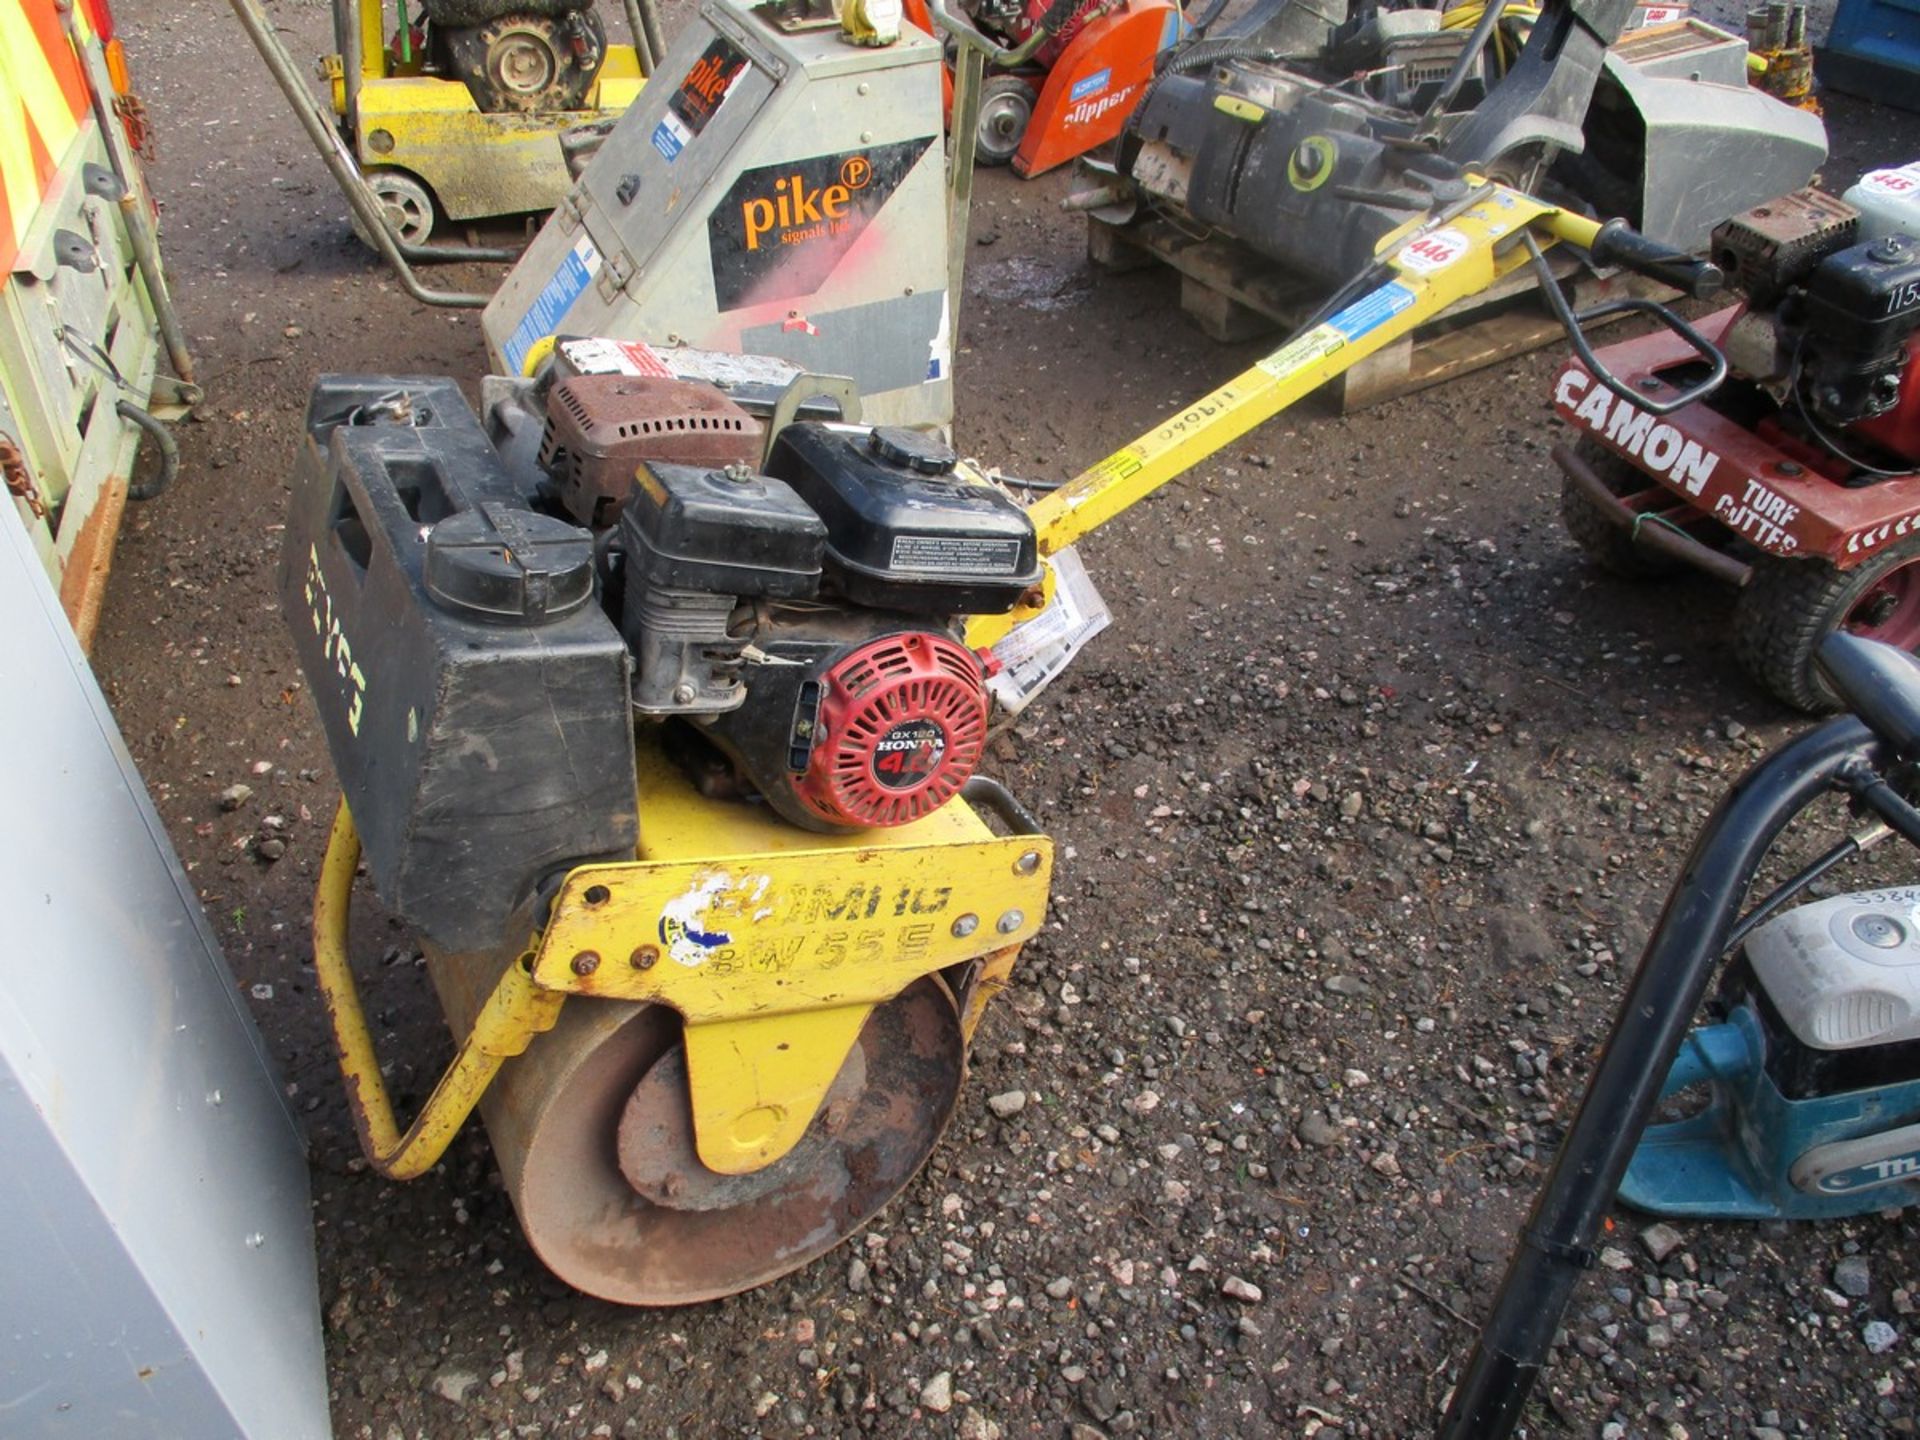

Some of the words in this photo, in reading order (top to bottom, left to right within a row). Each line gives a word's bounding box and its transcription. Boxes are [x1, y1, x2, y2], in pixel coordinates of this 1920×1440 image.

[743, 175, 849, 251] pike
[1410, 240, 1456, 262] 446
[1553, 368, 1721, 497] CAMON
[1742, 478, 1800, 526] TURF
